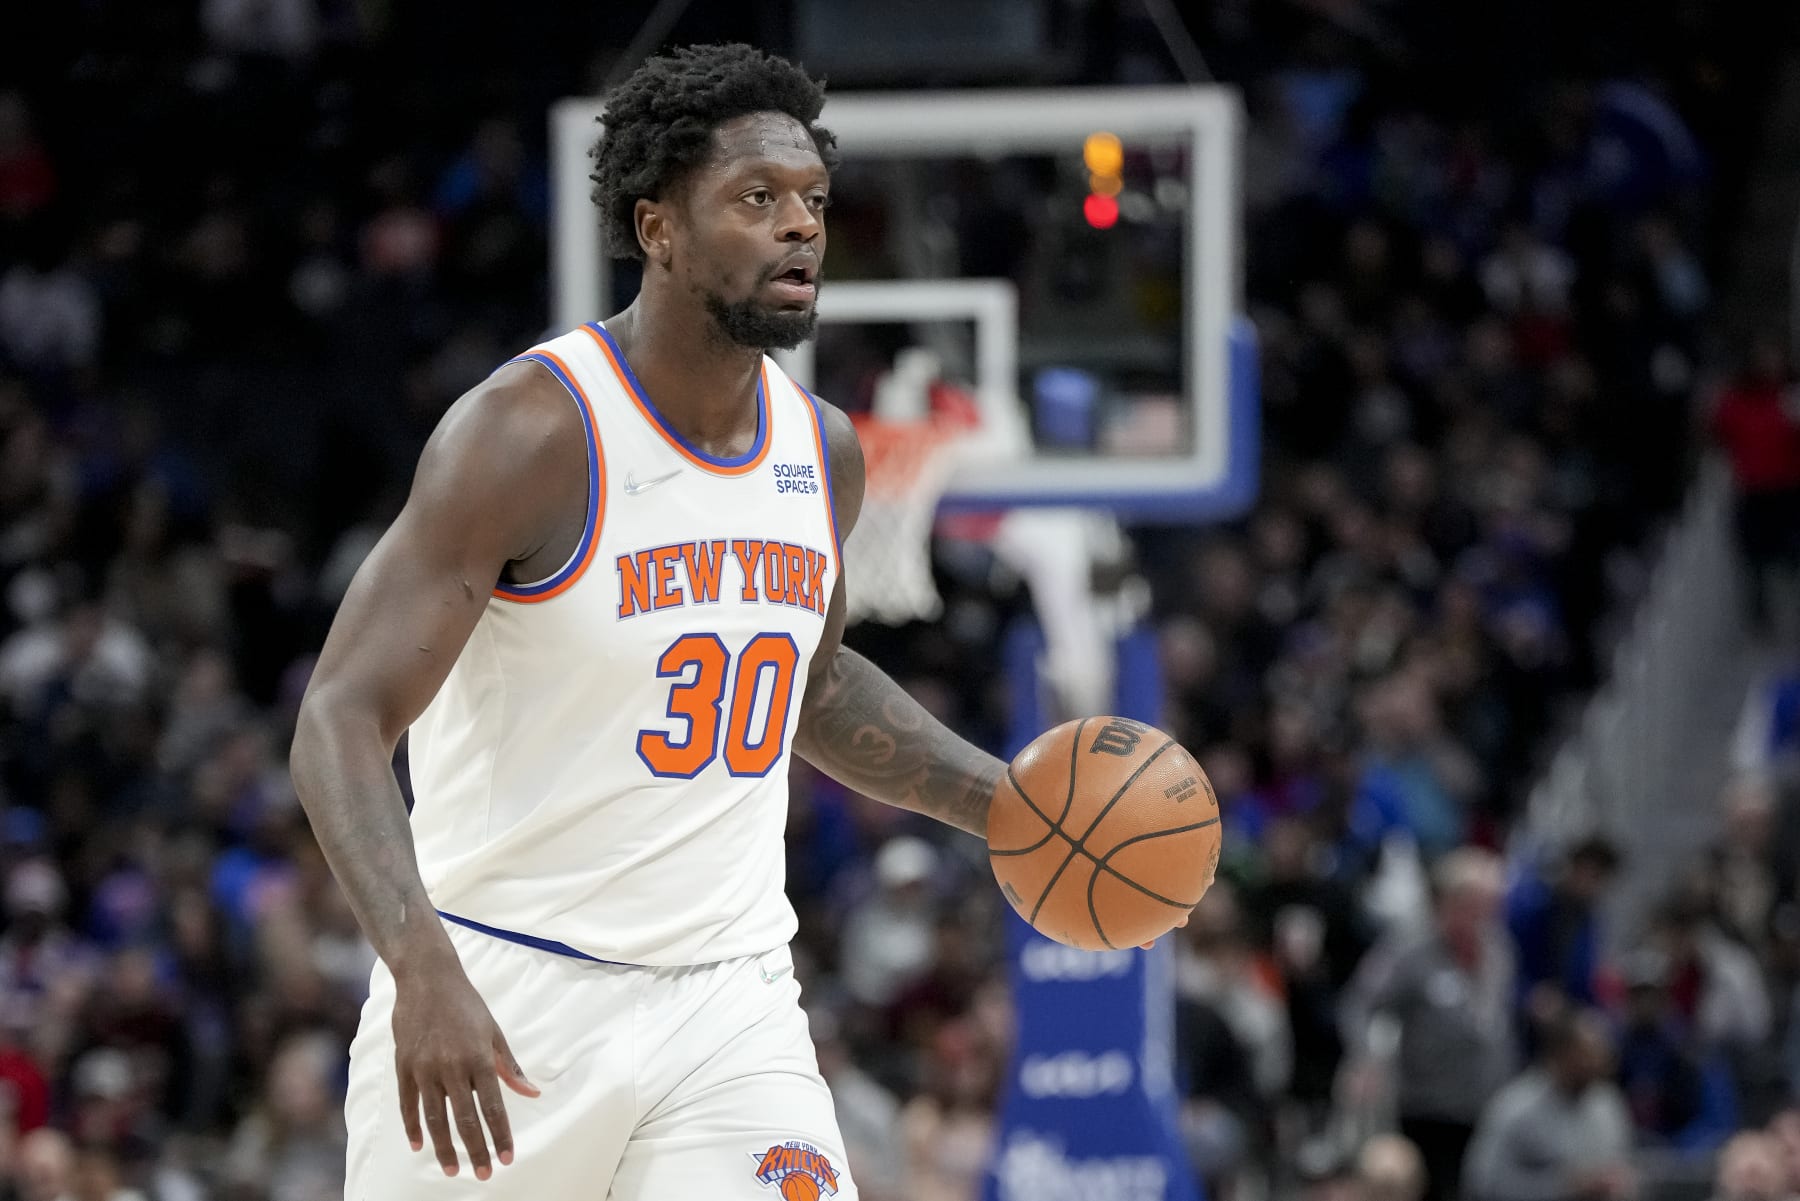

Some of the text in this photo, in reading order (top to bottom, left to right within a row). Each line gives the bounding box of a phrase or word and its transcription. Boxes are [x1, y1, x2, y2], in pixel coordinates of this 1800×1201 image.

[773, 464, 814, 478] SQUARE
[776, 480, 809, 494] SPACE
[616, 538, 827, 620] NEW YORK
[636, 632, 800, 779] 30
[784, 1141, 800, 1149] NEW
[755, 1145, 838, 1195] KNICKS
